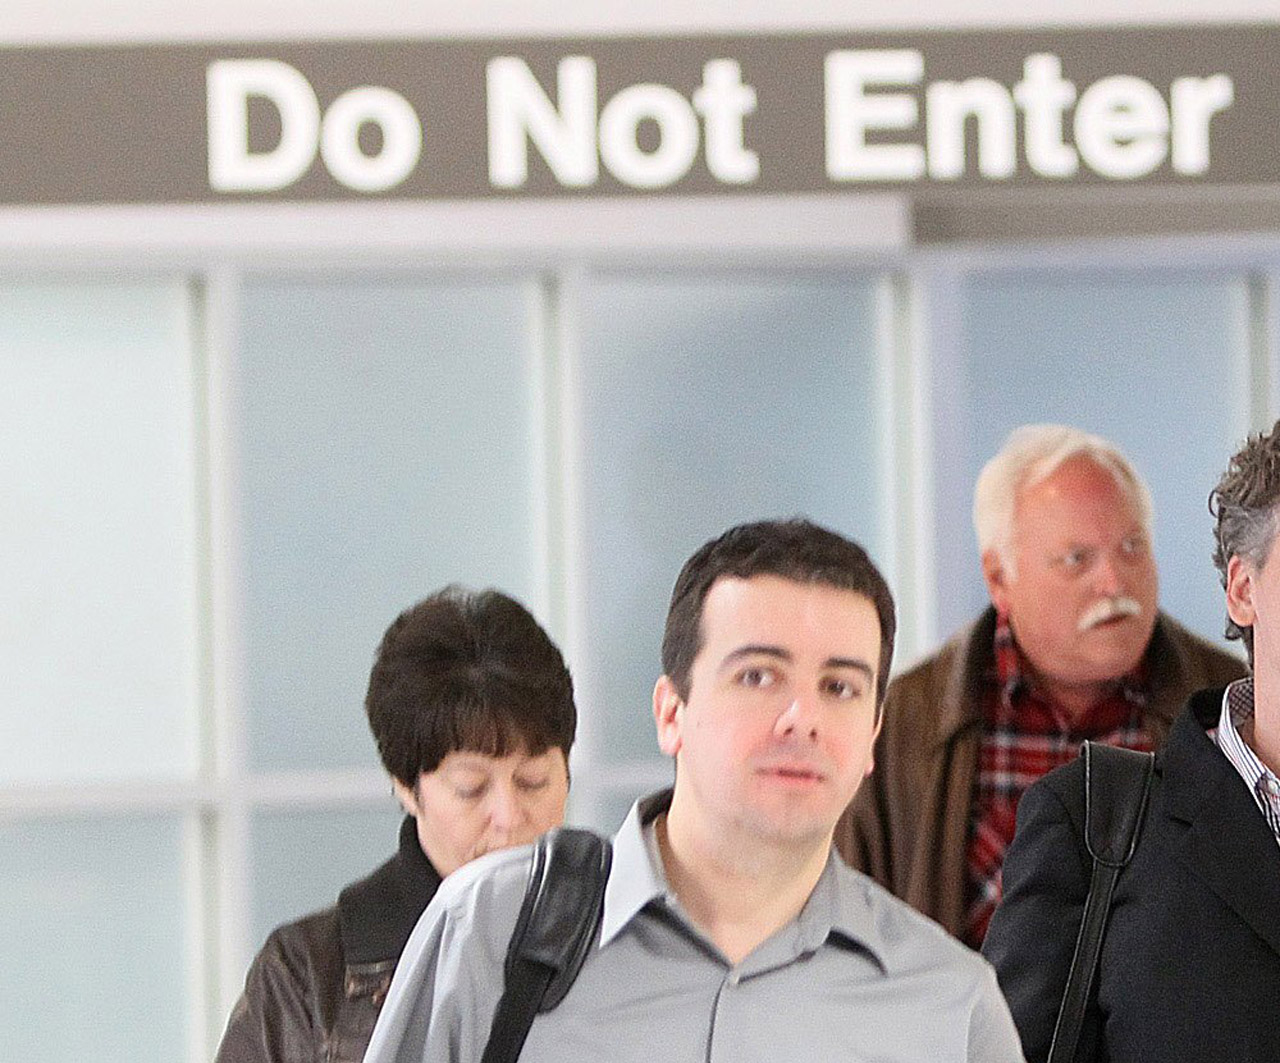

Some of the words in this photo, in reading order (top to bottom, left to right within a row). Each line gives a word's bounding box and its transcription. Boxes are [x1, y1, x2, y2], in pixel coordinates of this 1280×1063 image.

[207, 57, 421, 192] Do
[486, 55, 759, 190] Not
[823, 48, 1235, 182] Enter
